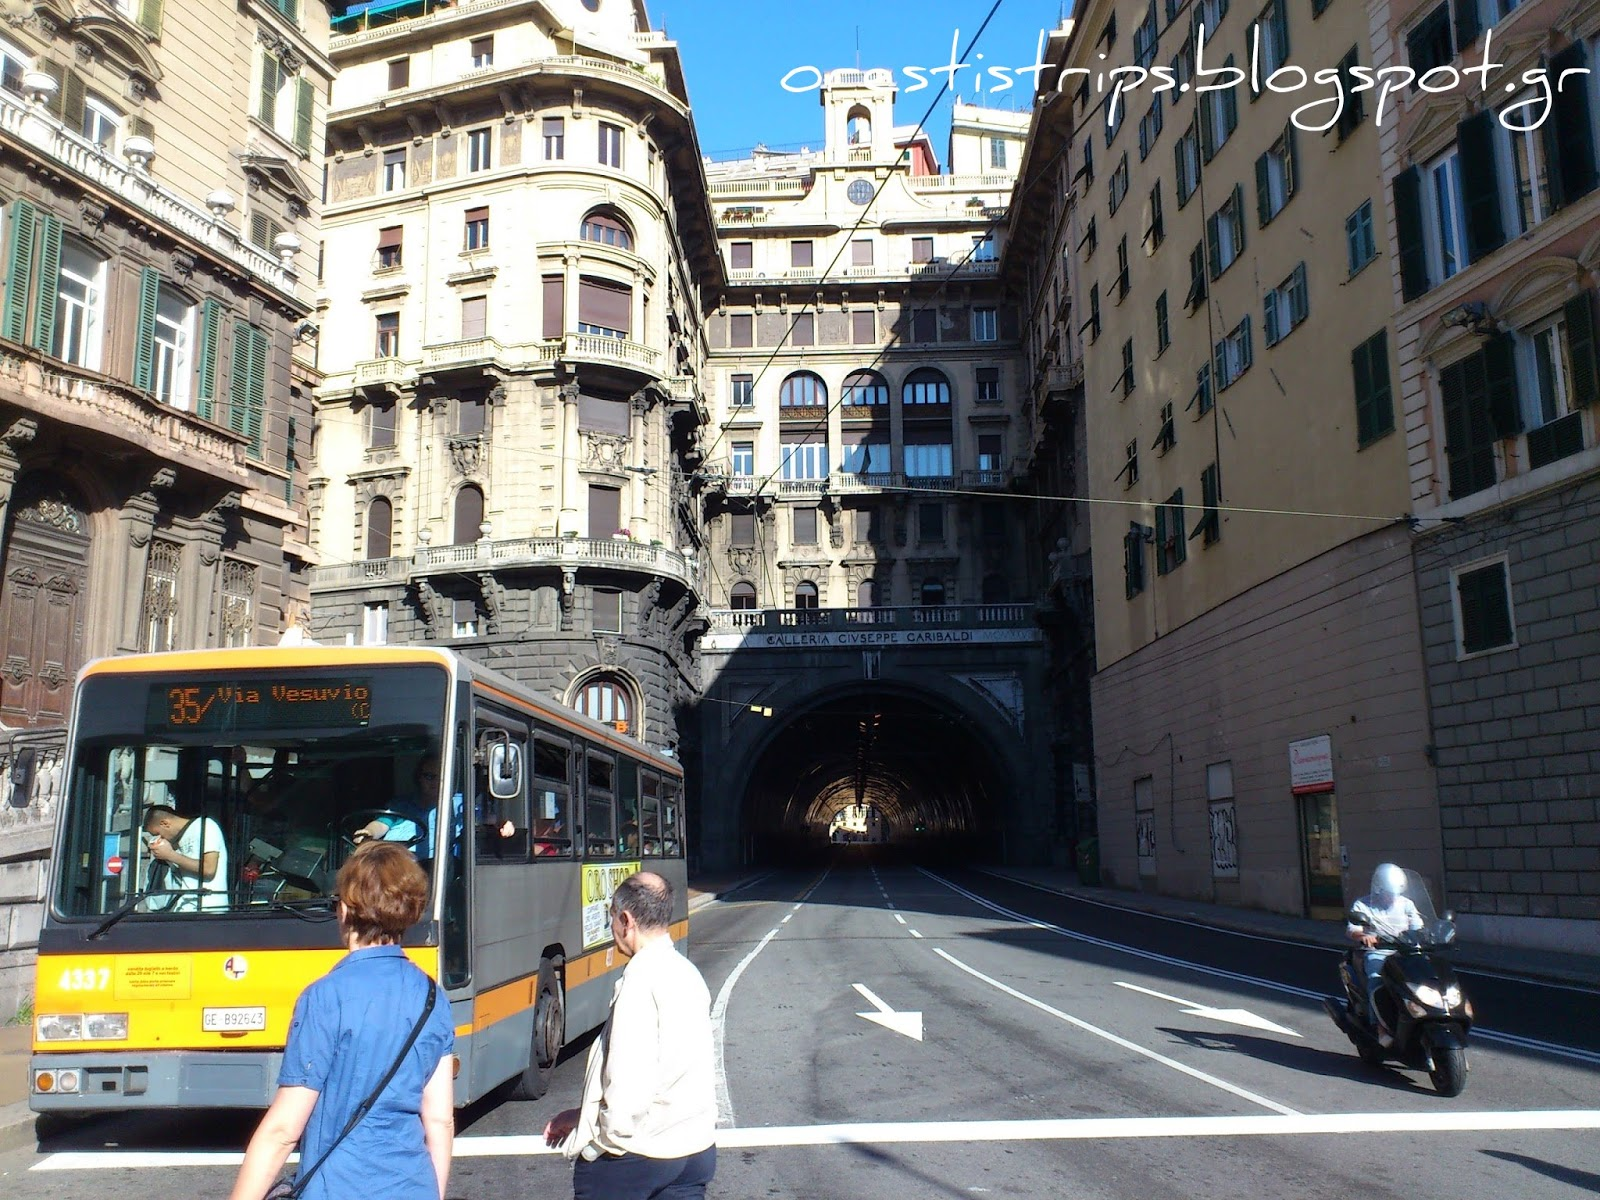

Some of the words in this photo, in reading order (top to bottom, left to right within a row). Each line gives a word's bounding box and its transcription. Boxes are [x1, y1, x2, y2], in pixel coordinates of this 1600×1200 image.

[169, 688, 215, 724] 35/
[217, 686, 260, 703] Via
[272, 683, 369, 702] Vesuvio
[58, 968, 110, 990] 4337
[205, 1013, 217, 1026] GE
[224, 1012, 264, 1025] B92643
